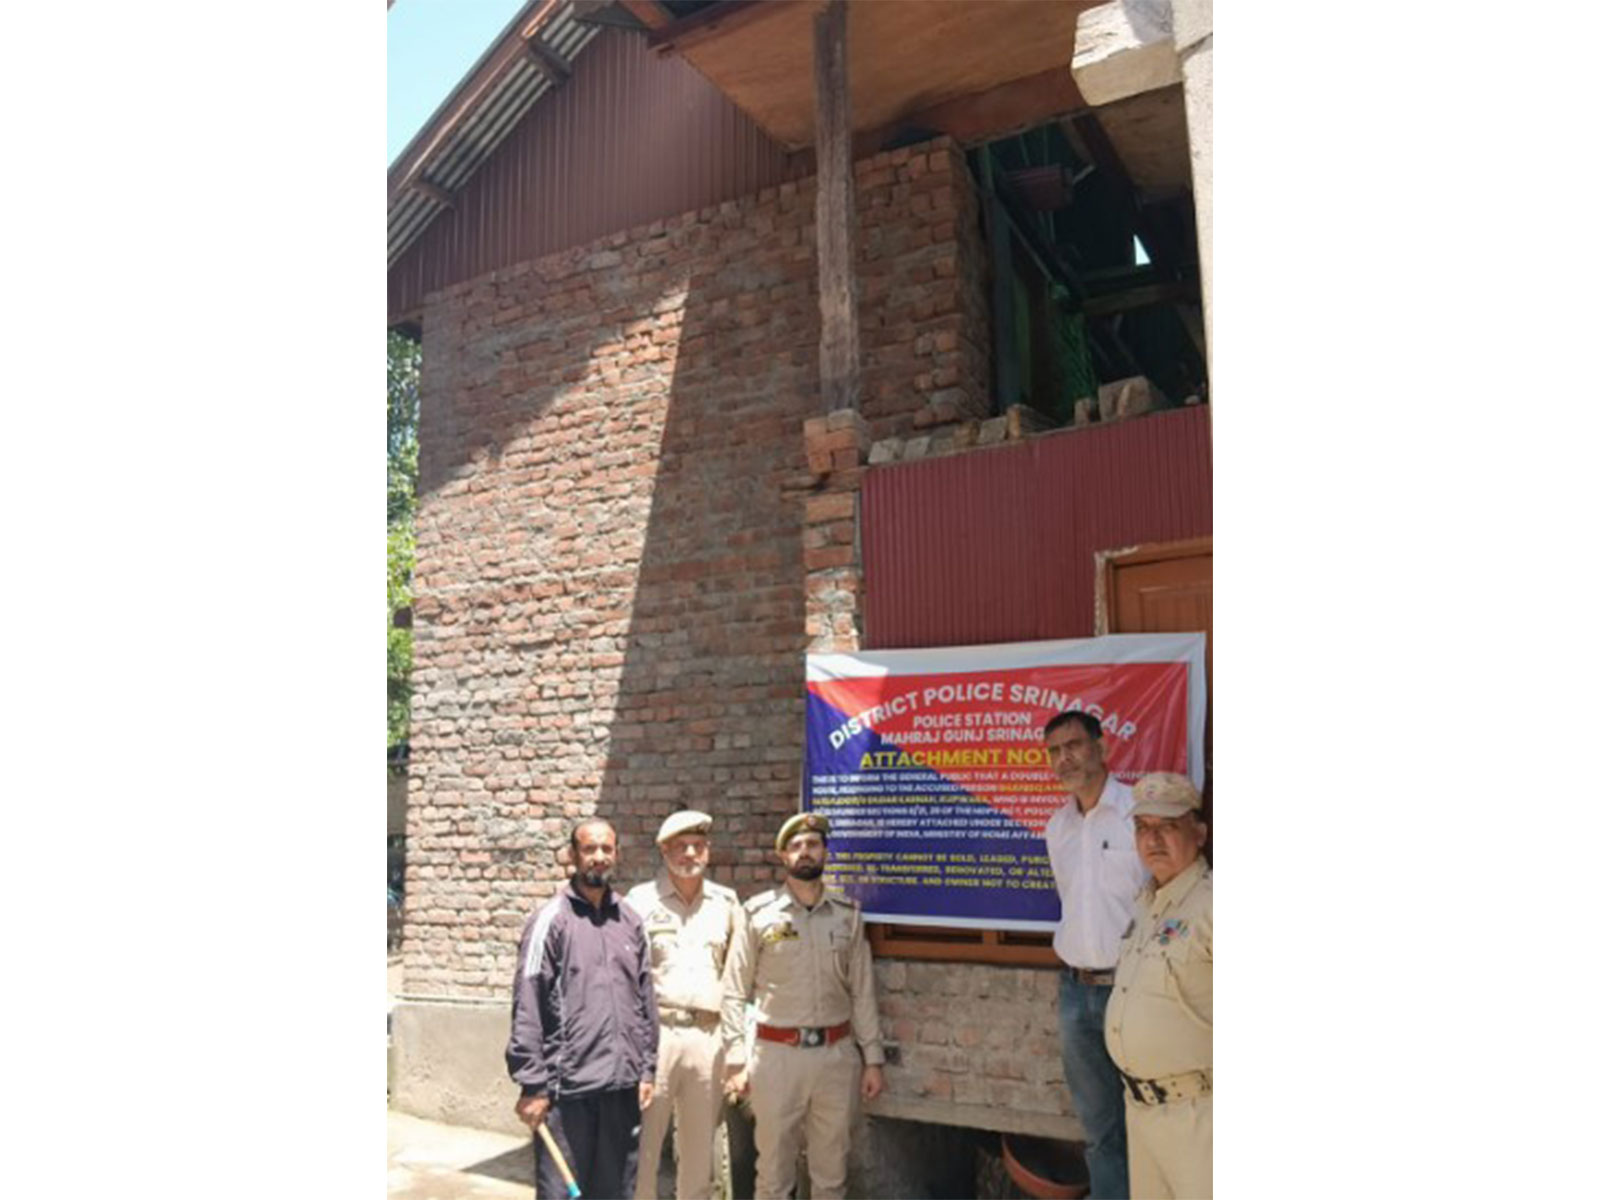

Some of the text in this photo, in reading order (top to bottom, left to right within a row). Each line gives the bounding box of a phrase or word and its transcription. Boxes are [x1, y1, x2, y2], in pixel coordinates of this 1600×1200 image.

[829, 691, 918, 750] DISTRICT
[924, 682, 1004, 706] POLICE
[914, 711, 1031, 728] POLICE STATION
[881, 727, 1045, 746] MAHRAJ GUNJ SRINAG
[860, 746, 1052, 770] ATTACHMENT NOT
[883, 773, 897, 781] THE
[899, 772, 938, 781] GENERAL
[975, 772, 998, 781] THAT
[1002, 772, 1010, 781] A
[886, 783, 897, 792] TO
[899, 783, 913, 792] THE
[914, 783, 959, 792] ACCUSED
[961, 782, 997, 791] PERSON
[955, 806, 972, 815] THE
[919, 817, 968, 827] ATTACHED
[970, 817, 1000, 827] UNDER
[923, 829, 965, 838] MINISTRY
[967, 829, 979, 838] OF
[982, 829, 1009, 838] HOME
[1007, 867, 1024, 876] OR
[982, 879, 1003, 888] NOT
[1005, 880, 1020, 888] TO
